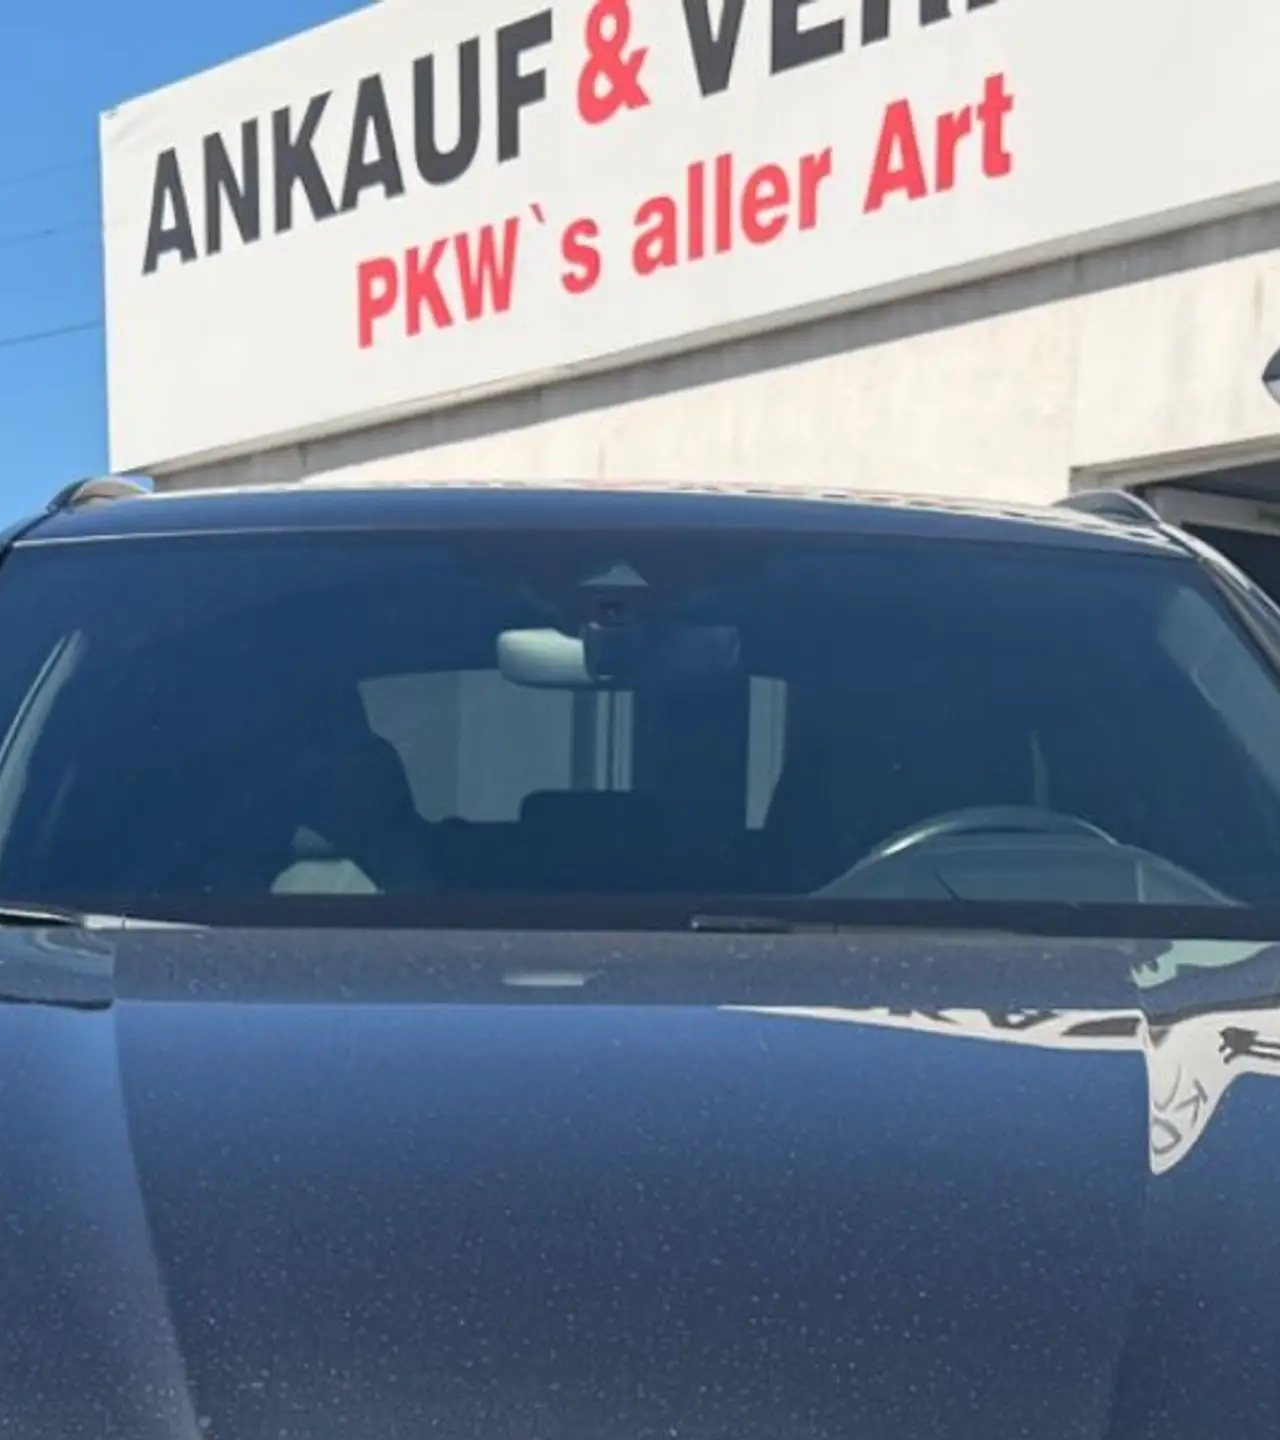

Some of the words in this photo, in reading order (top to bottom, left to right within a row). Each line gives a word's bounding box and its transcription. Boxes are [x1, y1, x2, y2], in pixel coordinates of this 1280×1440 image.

[141, 9, 555, 277] ANKAUF
[578, 0, 652, 124] &
[632, 147, 834, 278] aller
[862, 72, 1015, 215] Art
